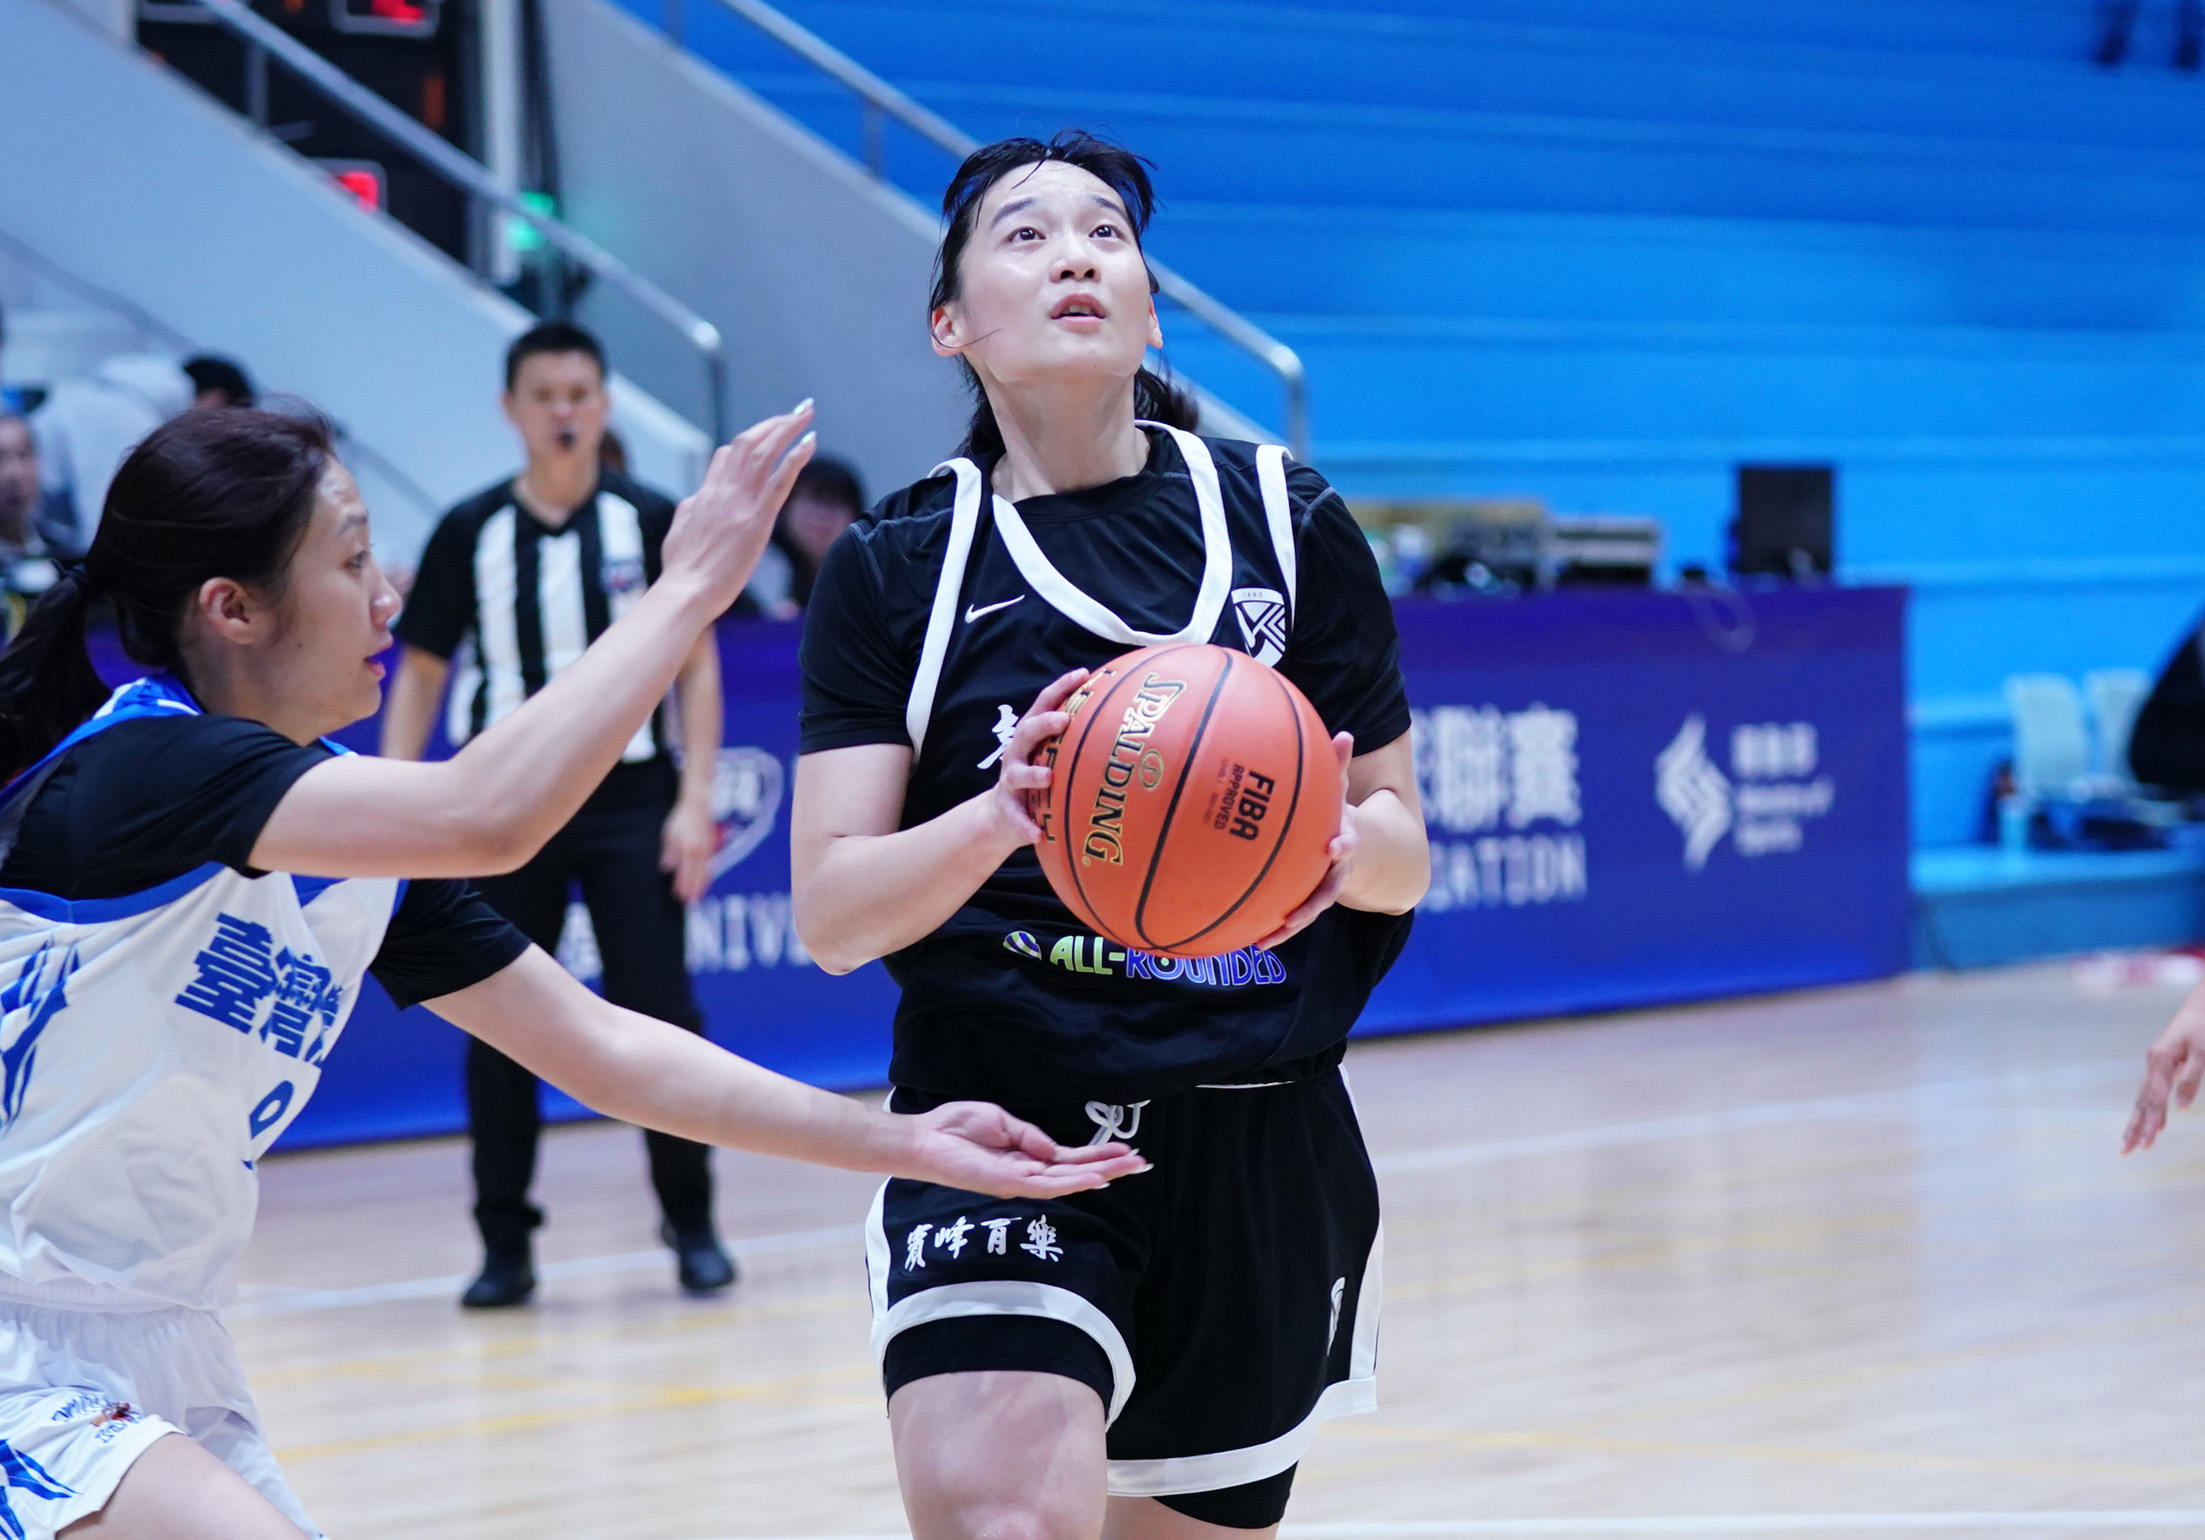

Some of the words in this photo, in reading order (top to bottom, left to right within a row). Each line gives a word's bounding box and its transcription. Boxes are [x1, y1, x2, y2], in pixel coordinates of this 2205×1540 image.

[1083, 671, 1187, 867] SPALDING
[1213, 763, 1245, 831] APPROVED
[1229, 770, 1275, 841] FIBA
[1049, 935, 1287, 986] ALL-ROUNDED
